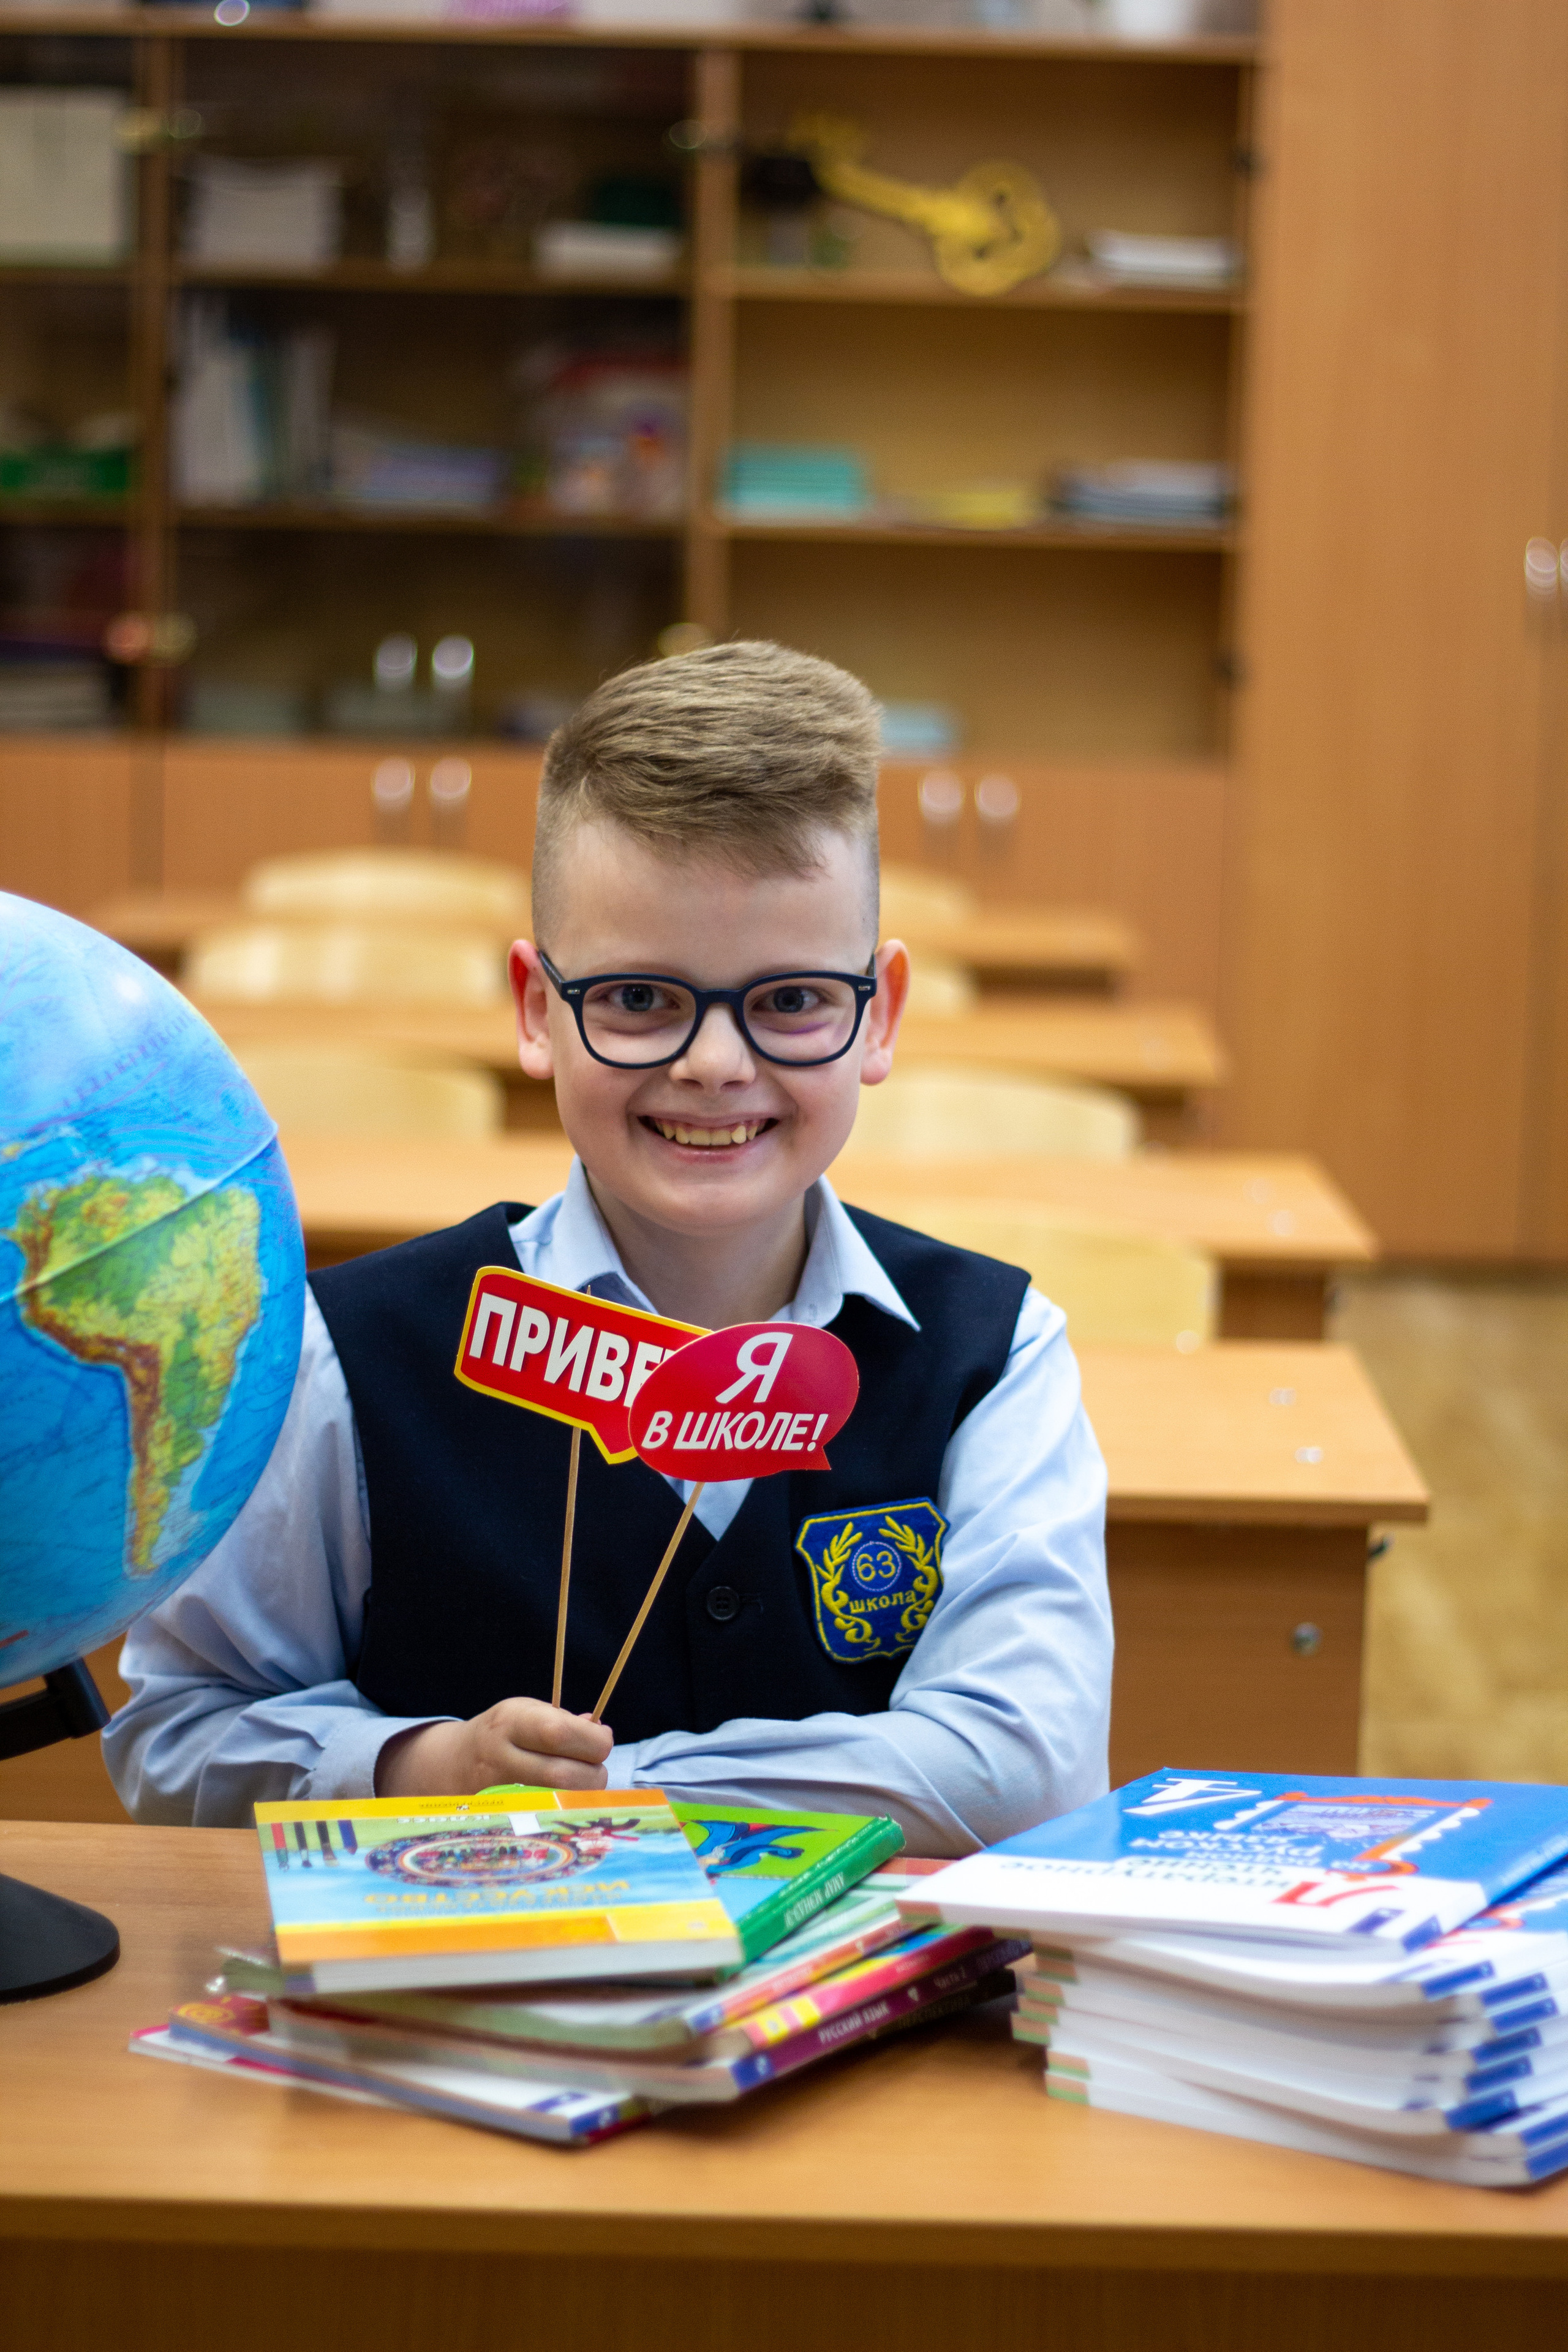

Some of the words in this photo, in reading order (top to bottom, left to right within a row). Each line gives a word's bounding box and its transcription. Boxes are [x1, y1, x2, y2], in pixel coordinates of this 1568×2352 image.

[469, 1292, 676, 1409] ПРИВЕ
[715, 1332, 794, 1404] Я
[641, 1411, 673, 1449] В
[673, 1411, 828, 1452] ШКОЛЕ!
[856, 1550, 896, 1581] 63
[848, 1589, 917, 1615] школа
[1122, 1777, 1263, 1815] 4
[1129, 1838, 1324, 1856] русском
[818, 2010, 863, 2045] РУССКИЙ
[862, 2000, 889, 2024] ЯЗЫК
